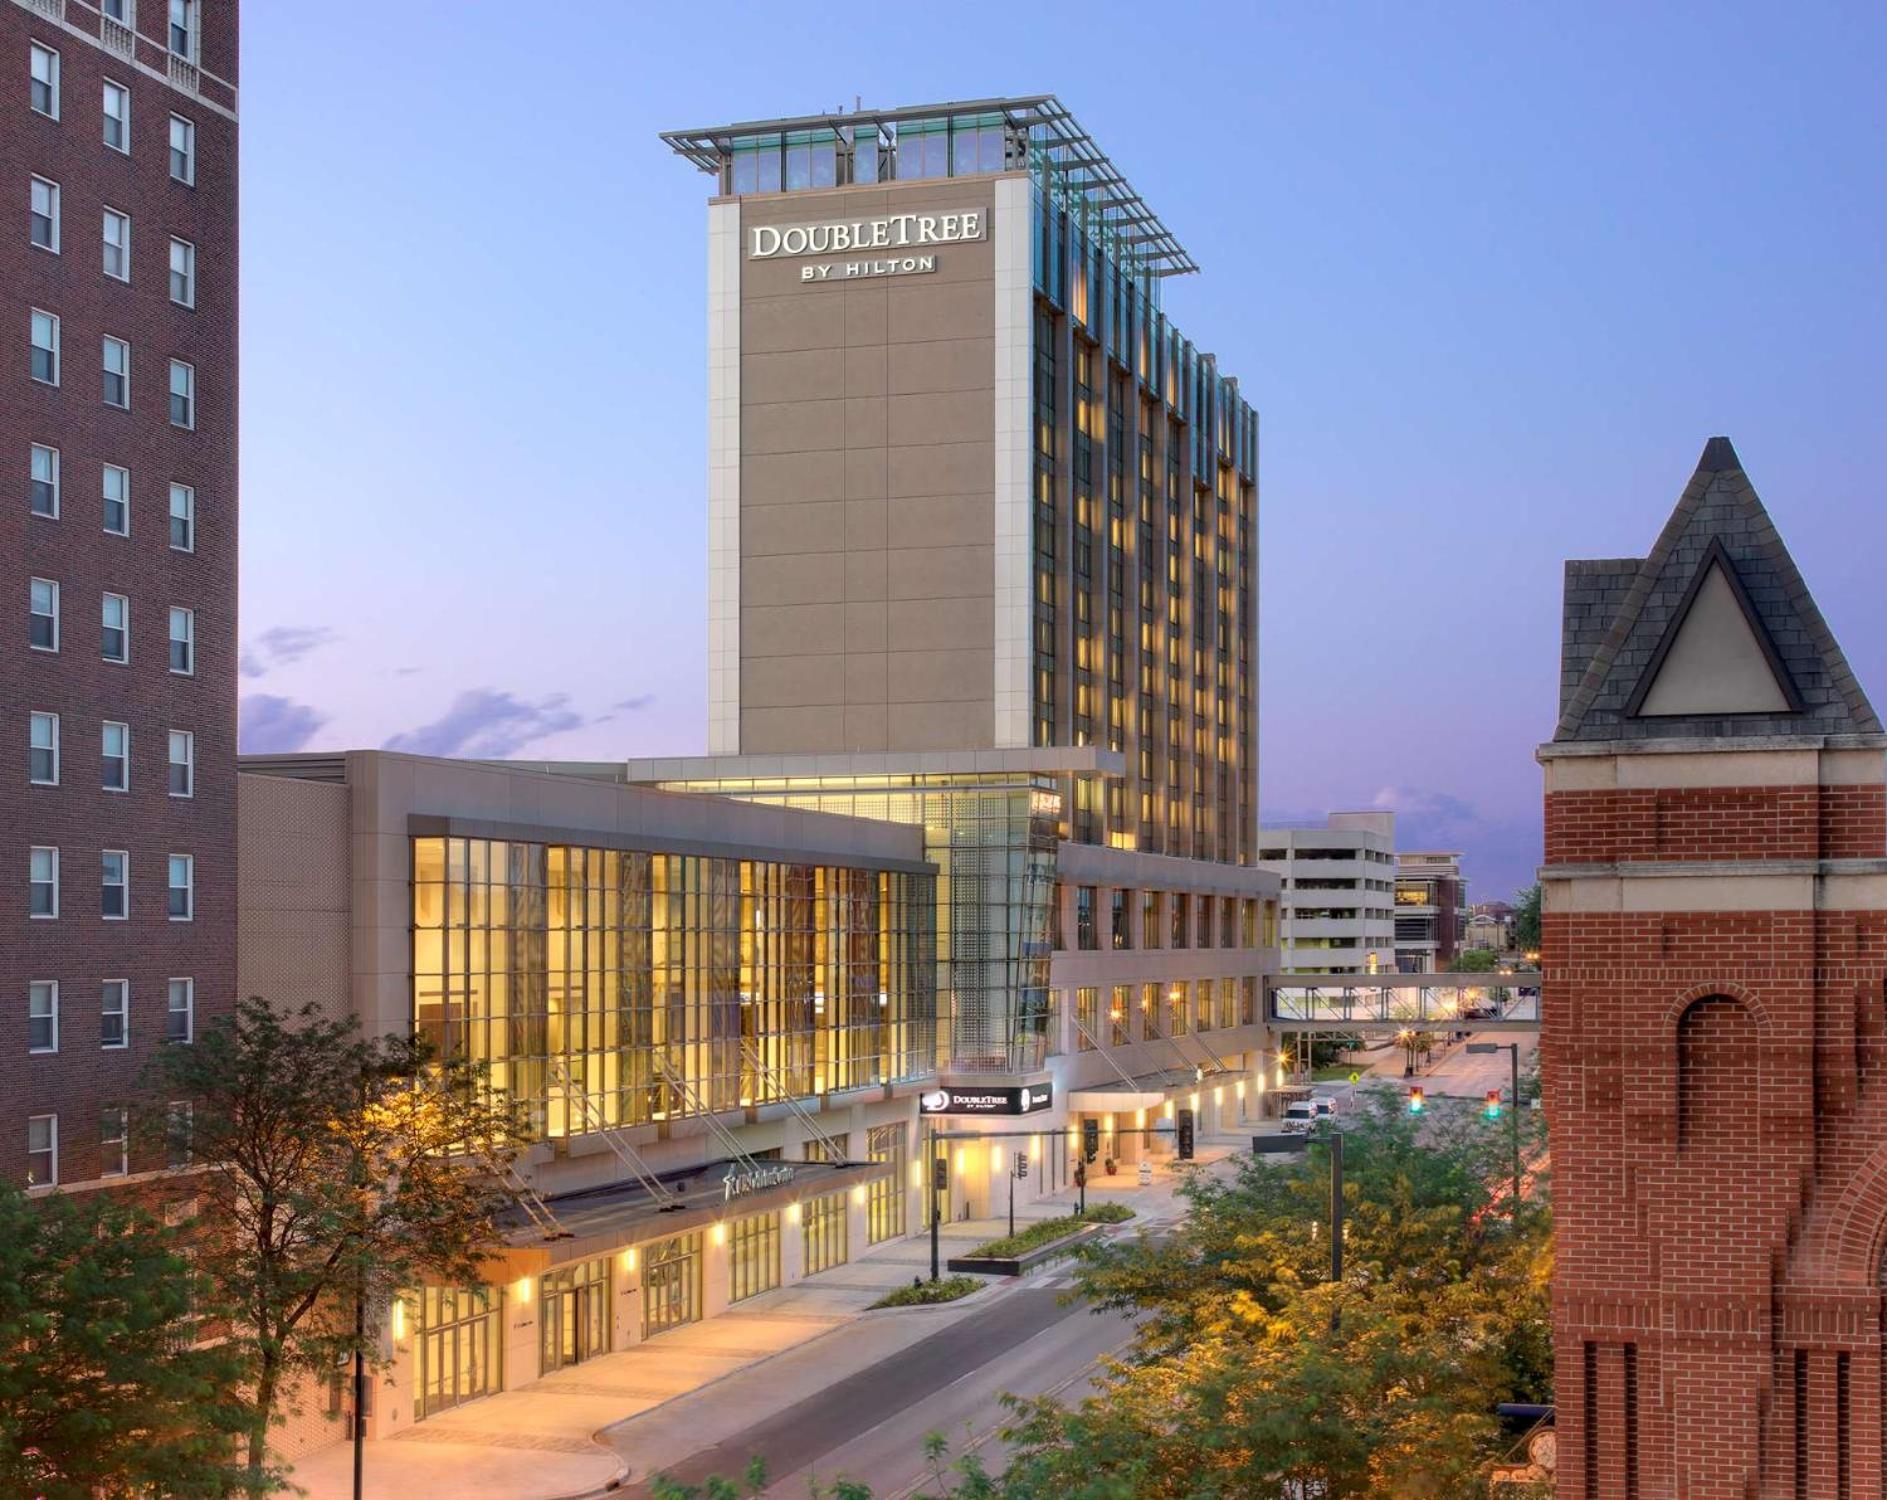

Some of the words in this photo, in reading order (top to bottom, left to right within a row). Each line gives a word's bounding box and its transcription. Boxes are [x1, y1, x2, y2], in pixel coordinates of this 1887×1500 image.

[752, 213, 981, 257] DOUBLETREE
[801, 265, 832, 279] BY
[846, 257, 933, 275] HILTON
